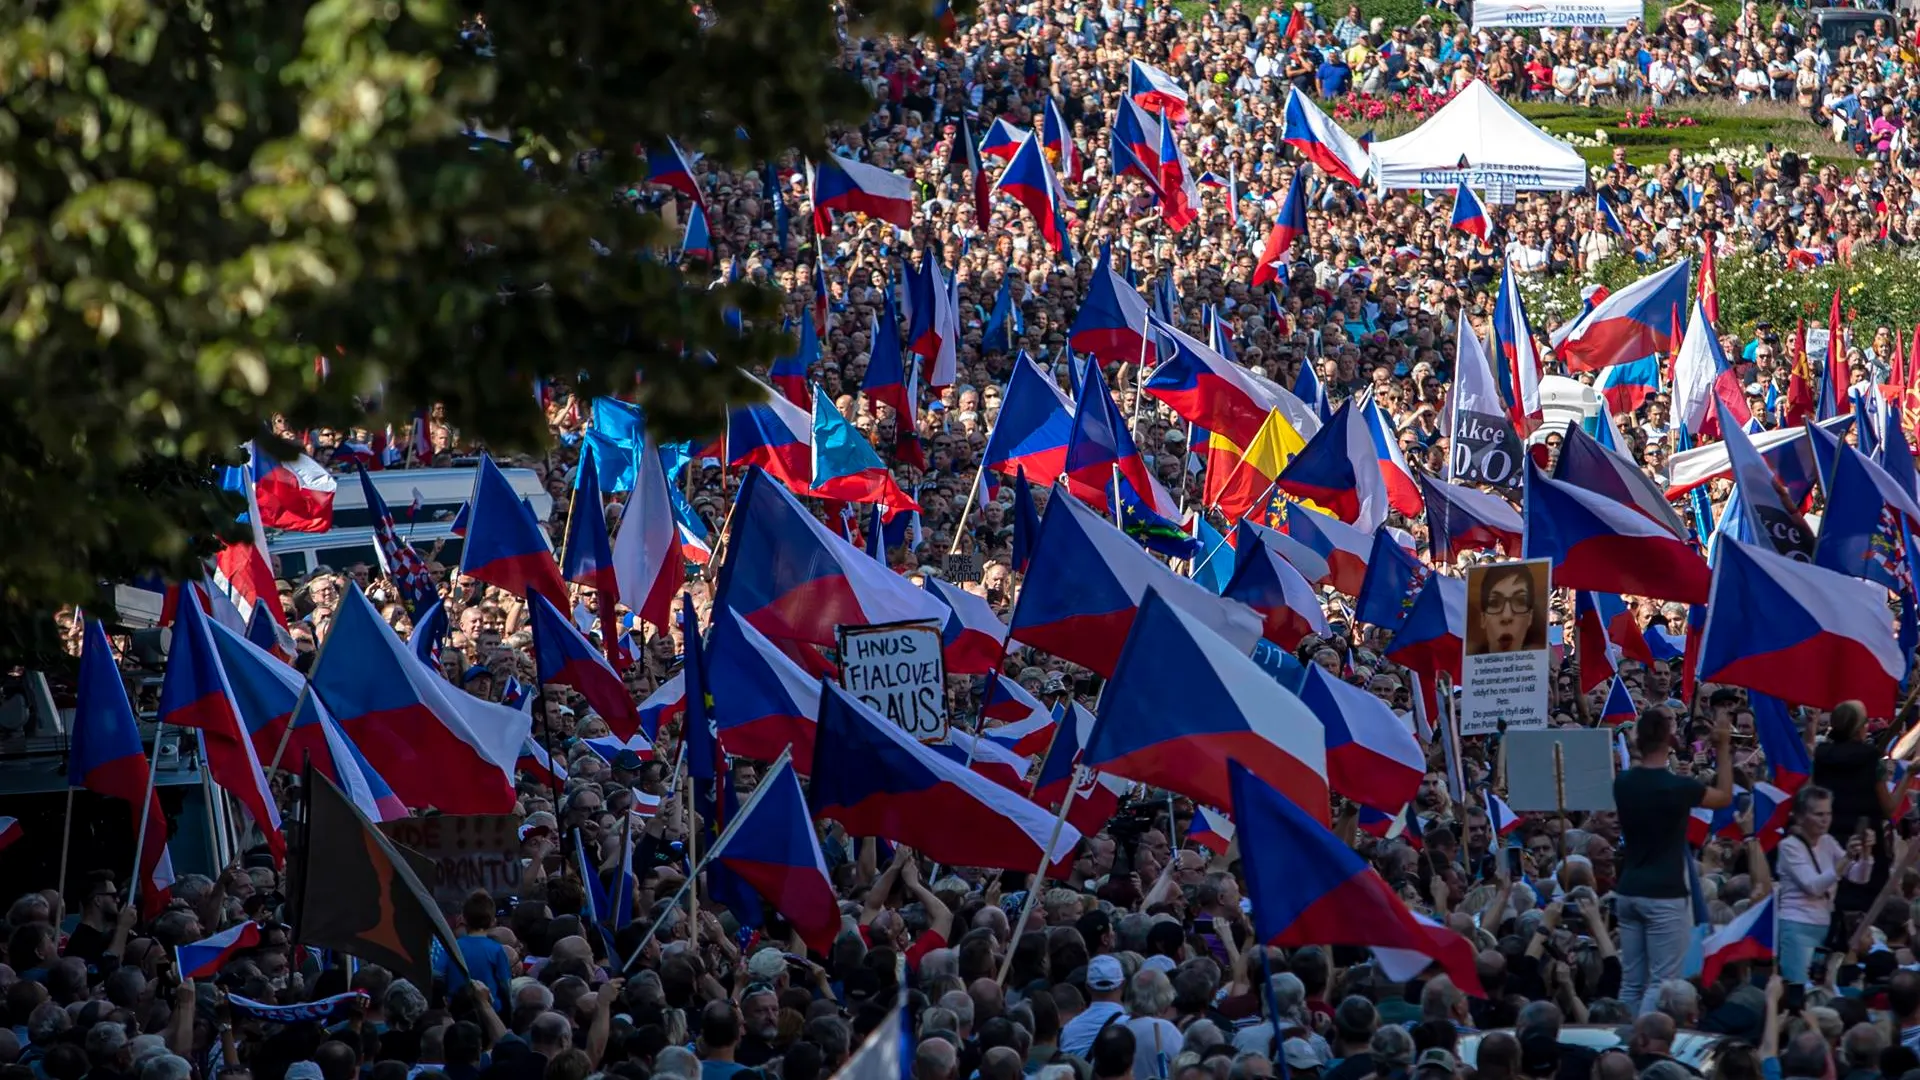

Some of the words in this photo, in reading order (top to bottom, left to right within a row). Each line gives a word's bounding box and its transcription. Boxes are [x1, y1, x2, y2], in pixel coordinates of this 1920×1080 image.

[1506, 13, 1547, 24] KNIHY
[1550, 12, 1607, 24] ZDARMA
[1480, 162, 1506, 170] FREE
[1420, 172, 1469, 185] KNIHY
[1474, 172, 1543, 185] ZDARMA
[1457, 417, 1505, 444] Akce
[856, 635, 917, 660] HNUS
[849, 658, 940, 691] FIALOVEJ
